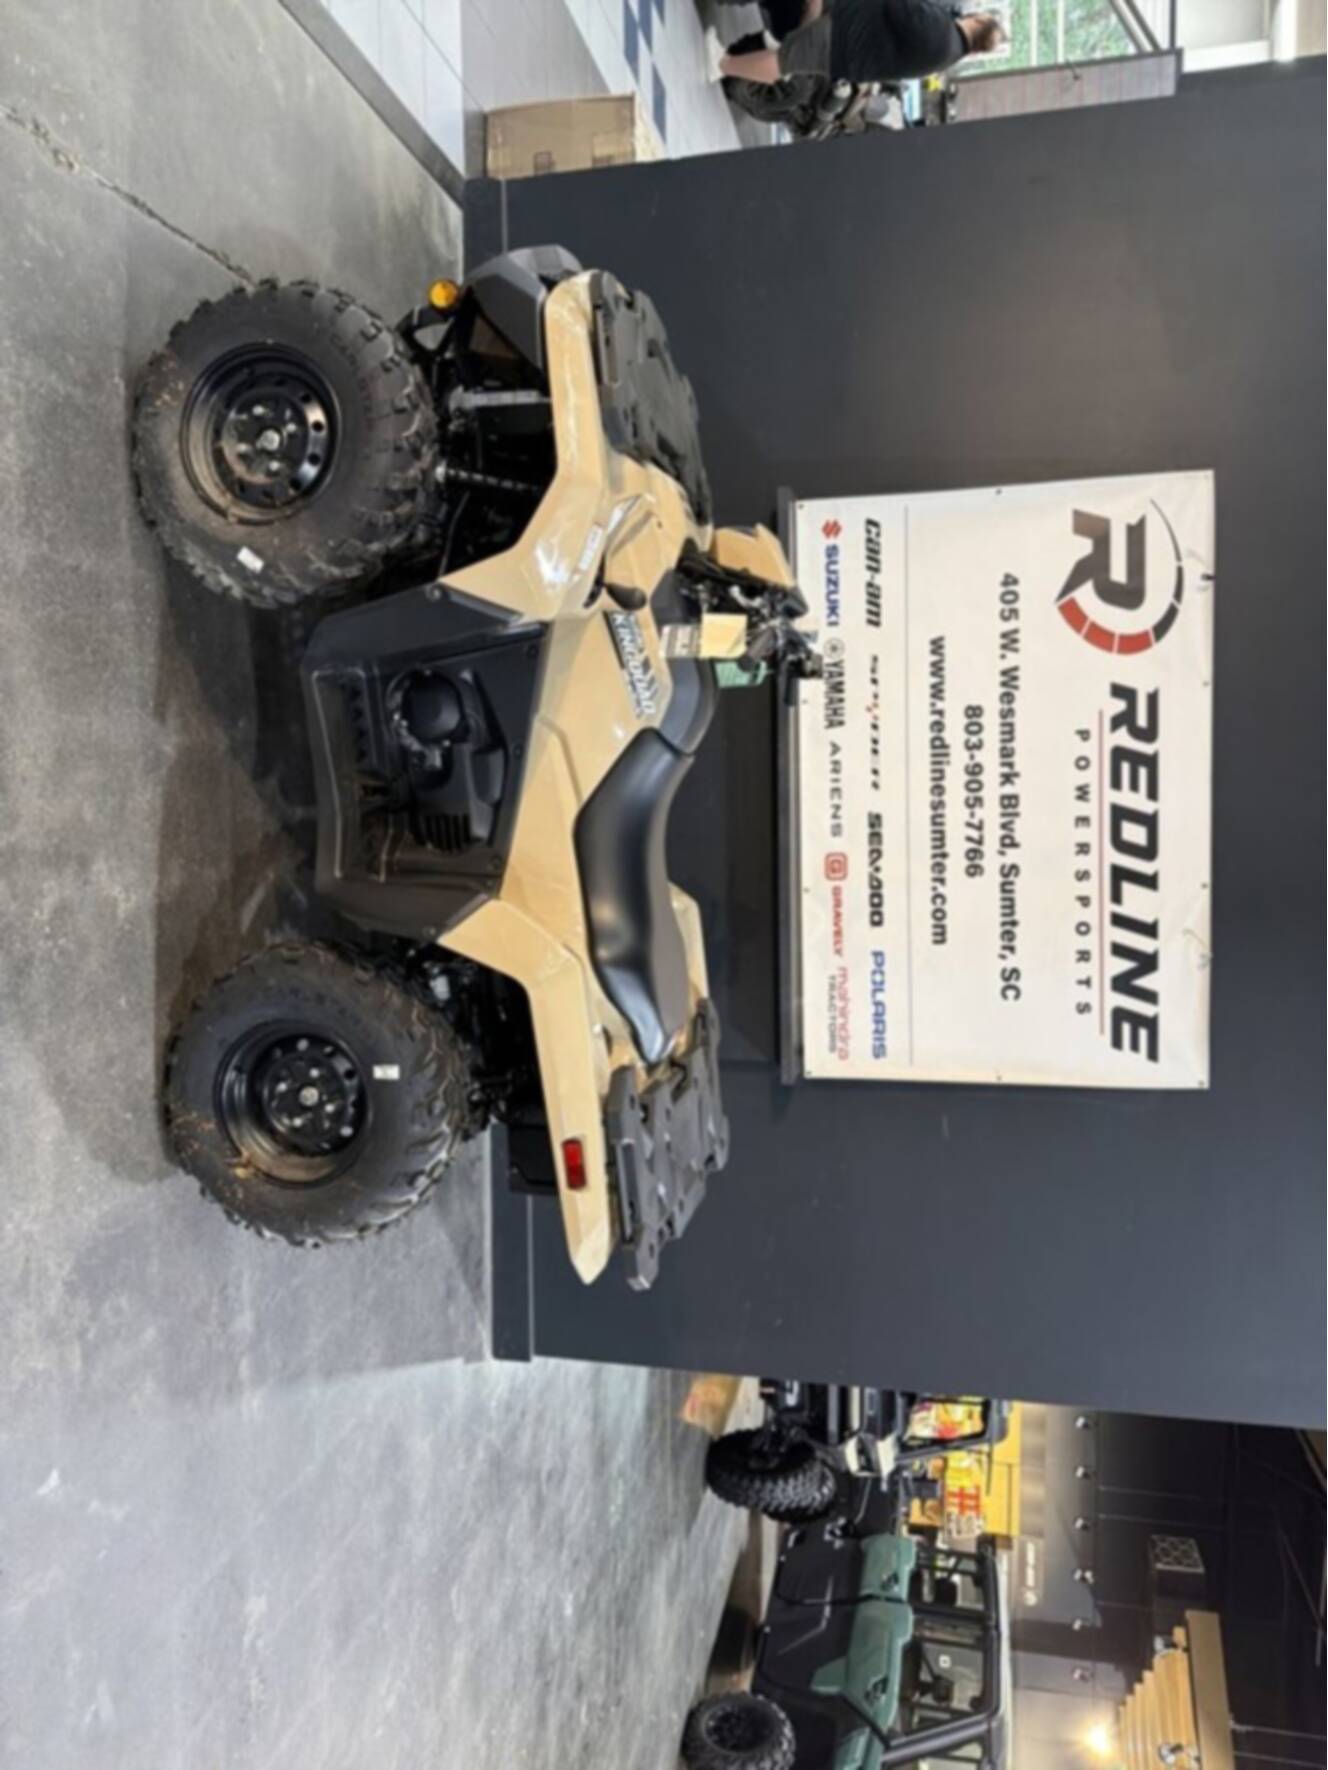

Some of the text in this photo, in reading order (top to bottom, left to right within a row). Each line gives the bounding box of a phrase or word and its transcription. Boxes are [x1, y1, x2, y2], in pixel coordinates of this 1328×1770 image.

[825, 543, 840, 627] SUZUKI
[823, 659, 845, 730] YAMAHA
[829, 741, 842, 838] ARIENS
[928, 636, 950, 946] www.redlinesumter.com
[963, 704, 985, 879] 803-905-7766
[996, 573, 1021, 1001] 405 W. Wesmark Blvd, Sumter, SC
[831, 885, 844, 958] GRAVELY
[1074, 729, 1092, 1015] POWERSPORTS
[1110, 682, 1159, 1063] REDLINE
[827, 974, 838, 1054] TRACTORS
[837, 967, 850, 1062] mahindra
[870, 950, 887, 1060] POLARIS
